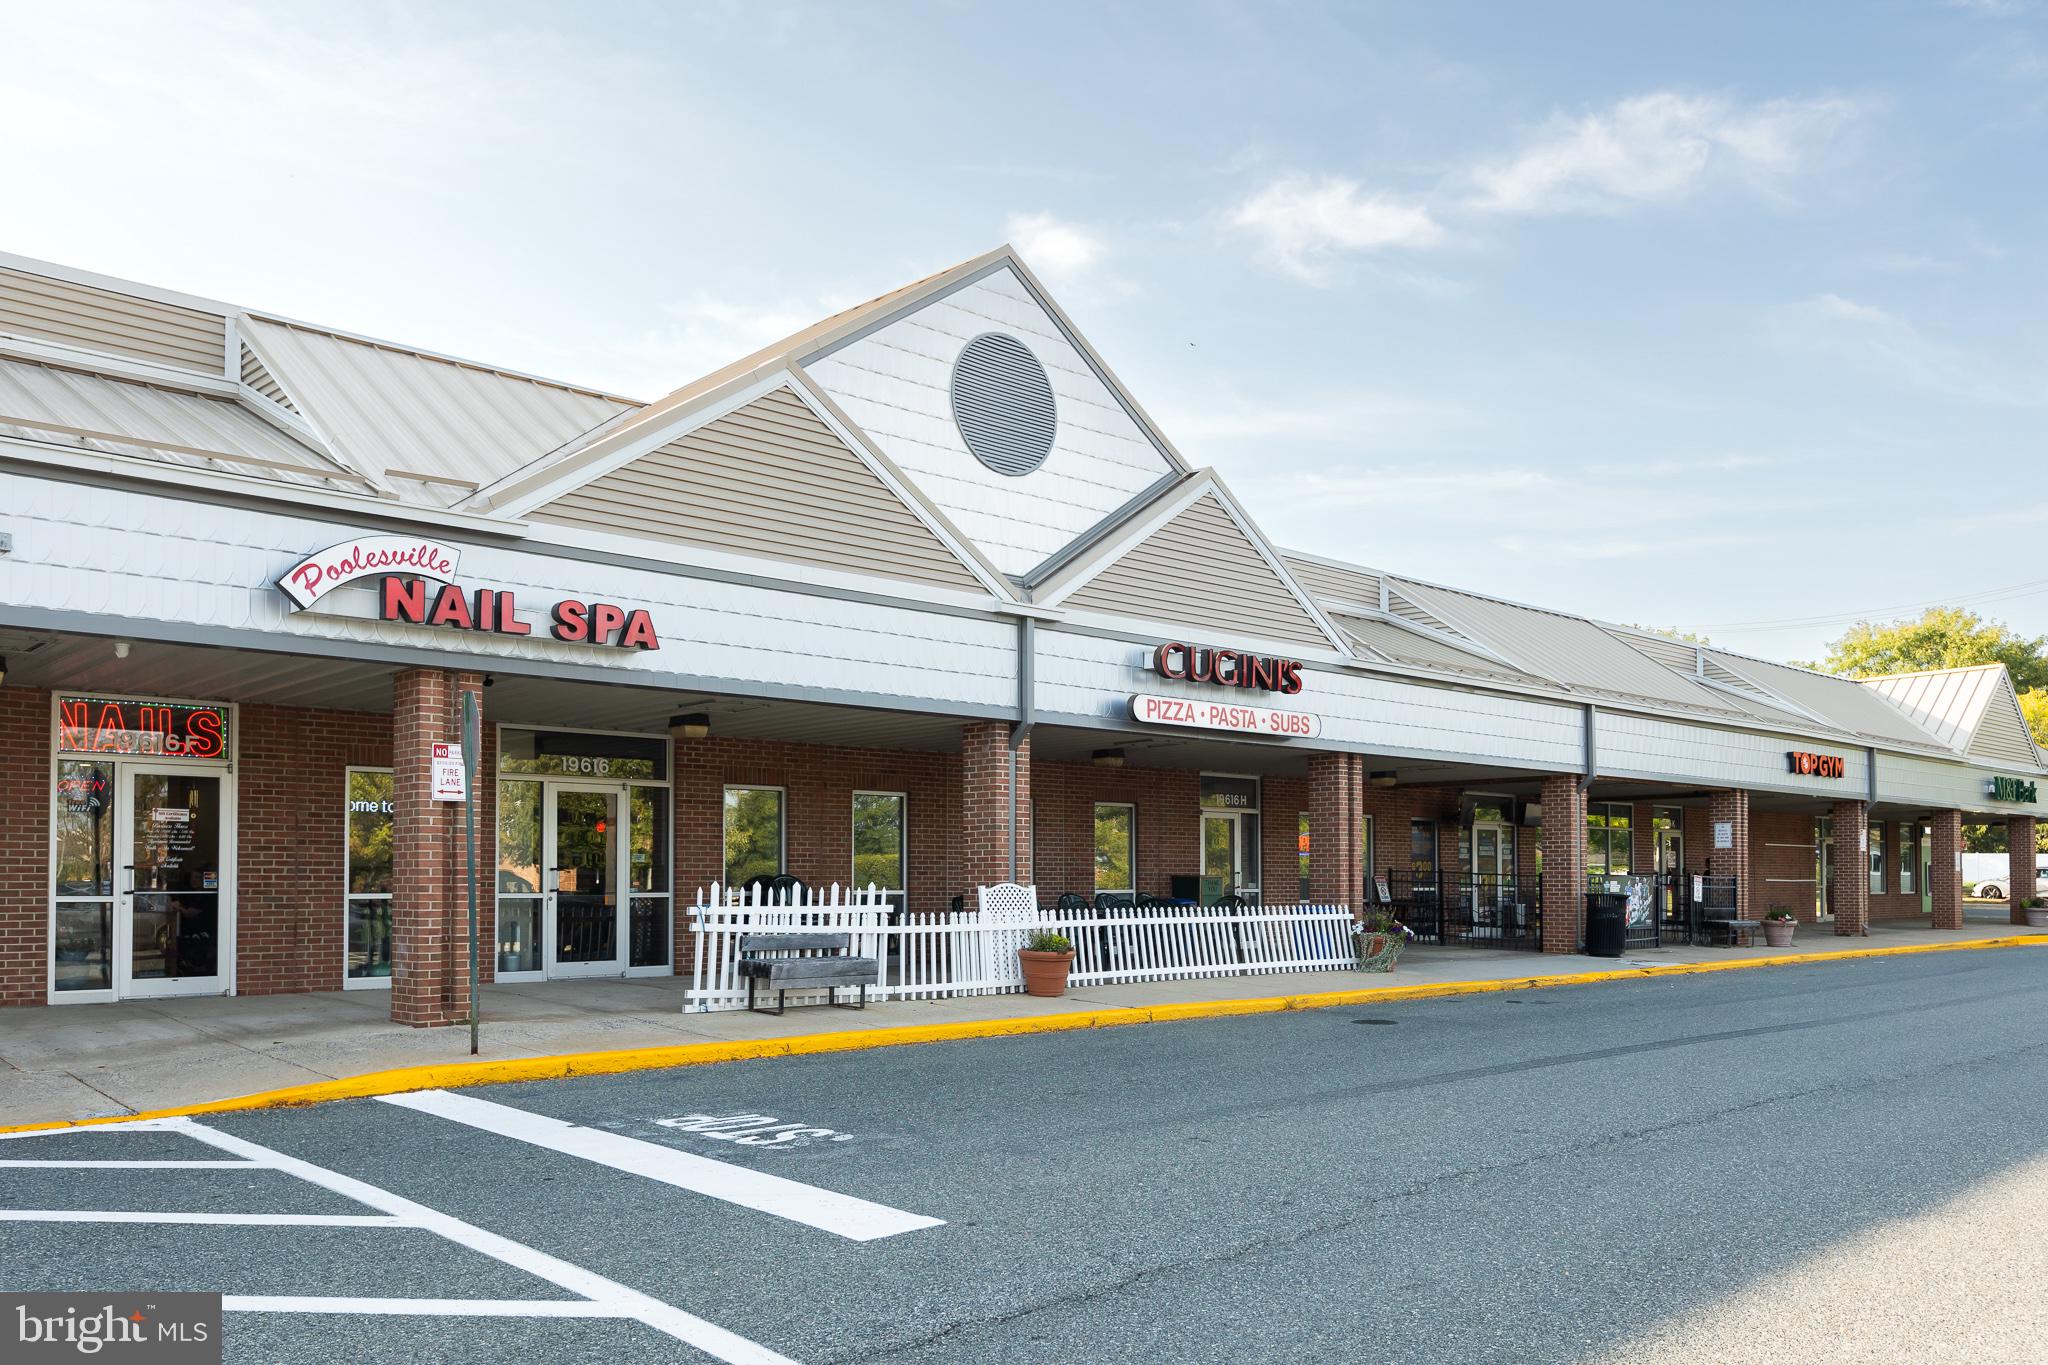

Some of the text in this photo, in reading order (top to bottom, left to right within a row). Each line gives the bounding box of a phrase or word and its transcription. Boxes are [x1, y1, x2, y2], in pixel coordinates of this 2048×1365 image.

[291, 545, 452, 597] Poolesville
[380, 576, 660, 649] NAIL SPA
[1154, 642, 1304, 694] CUGINI'S
[60, 702, 223, 758] NAILS
[1147, 698, 1310, 735] PIZZA PASTA SUBS
[436, 747, 448, 757] NO
[562, 756, 610, 774] 19616
[1792, 751, 1844, 778] TOP GYM
[57, 780, 106, 792] OPEN
[440, 777, 461, 786] LANE
[442, 768, 459, 777] FIRE
